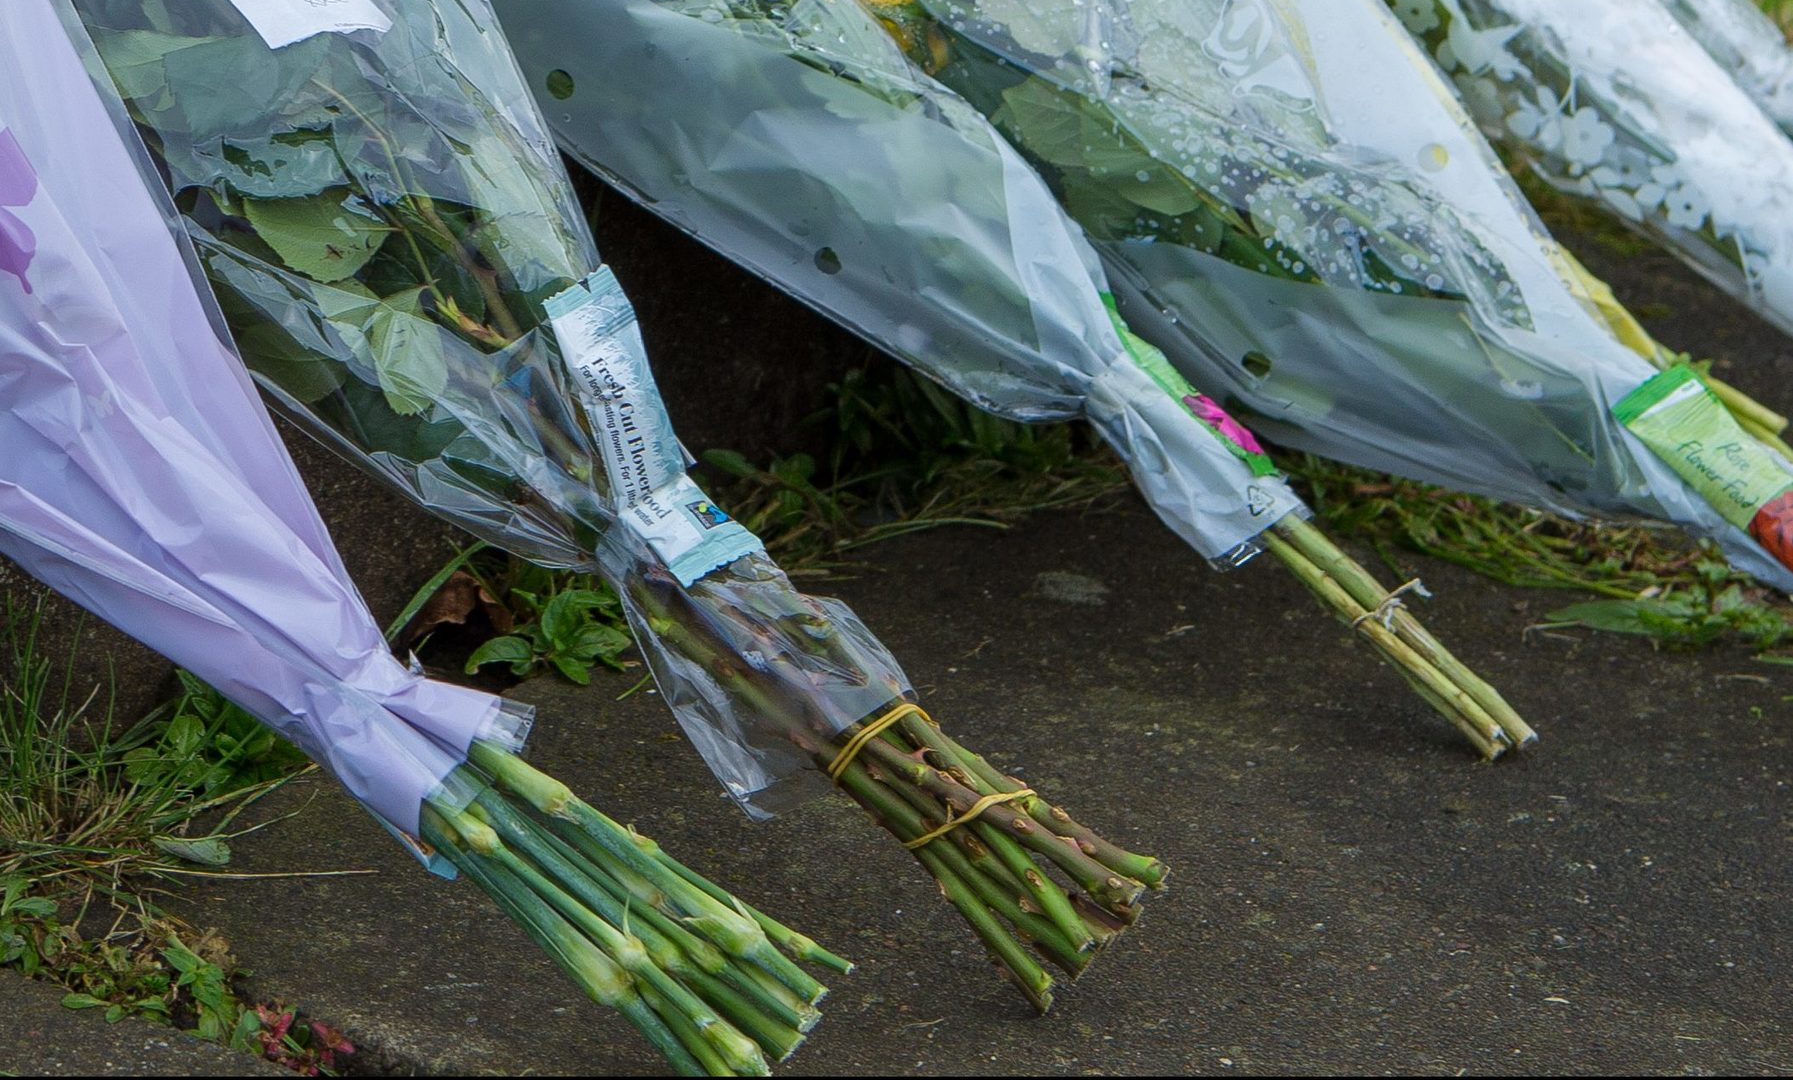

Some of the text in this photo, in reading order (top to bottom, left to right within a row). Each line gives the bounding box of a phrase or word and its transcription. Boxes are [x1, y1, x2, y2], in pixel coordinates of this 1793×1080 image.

[592, 357, 626, 399] Fresh
[619, 402, 639, 432] Cut
[580, 365, 592, 379] For
[588, 379, 609, 402] longe
[621, 465, 631, 480] For
[634, 507, 655, 526] water
[1677, 440, 1759, 508] Flower Food
[1716, 442, 1749, 471] Rose
